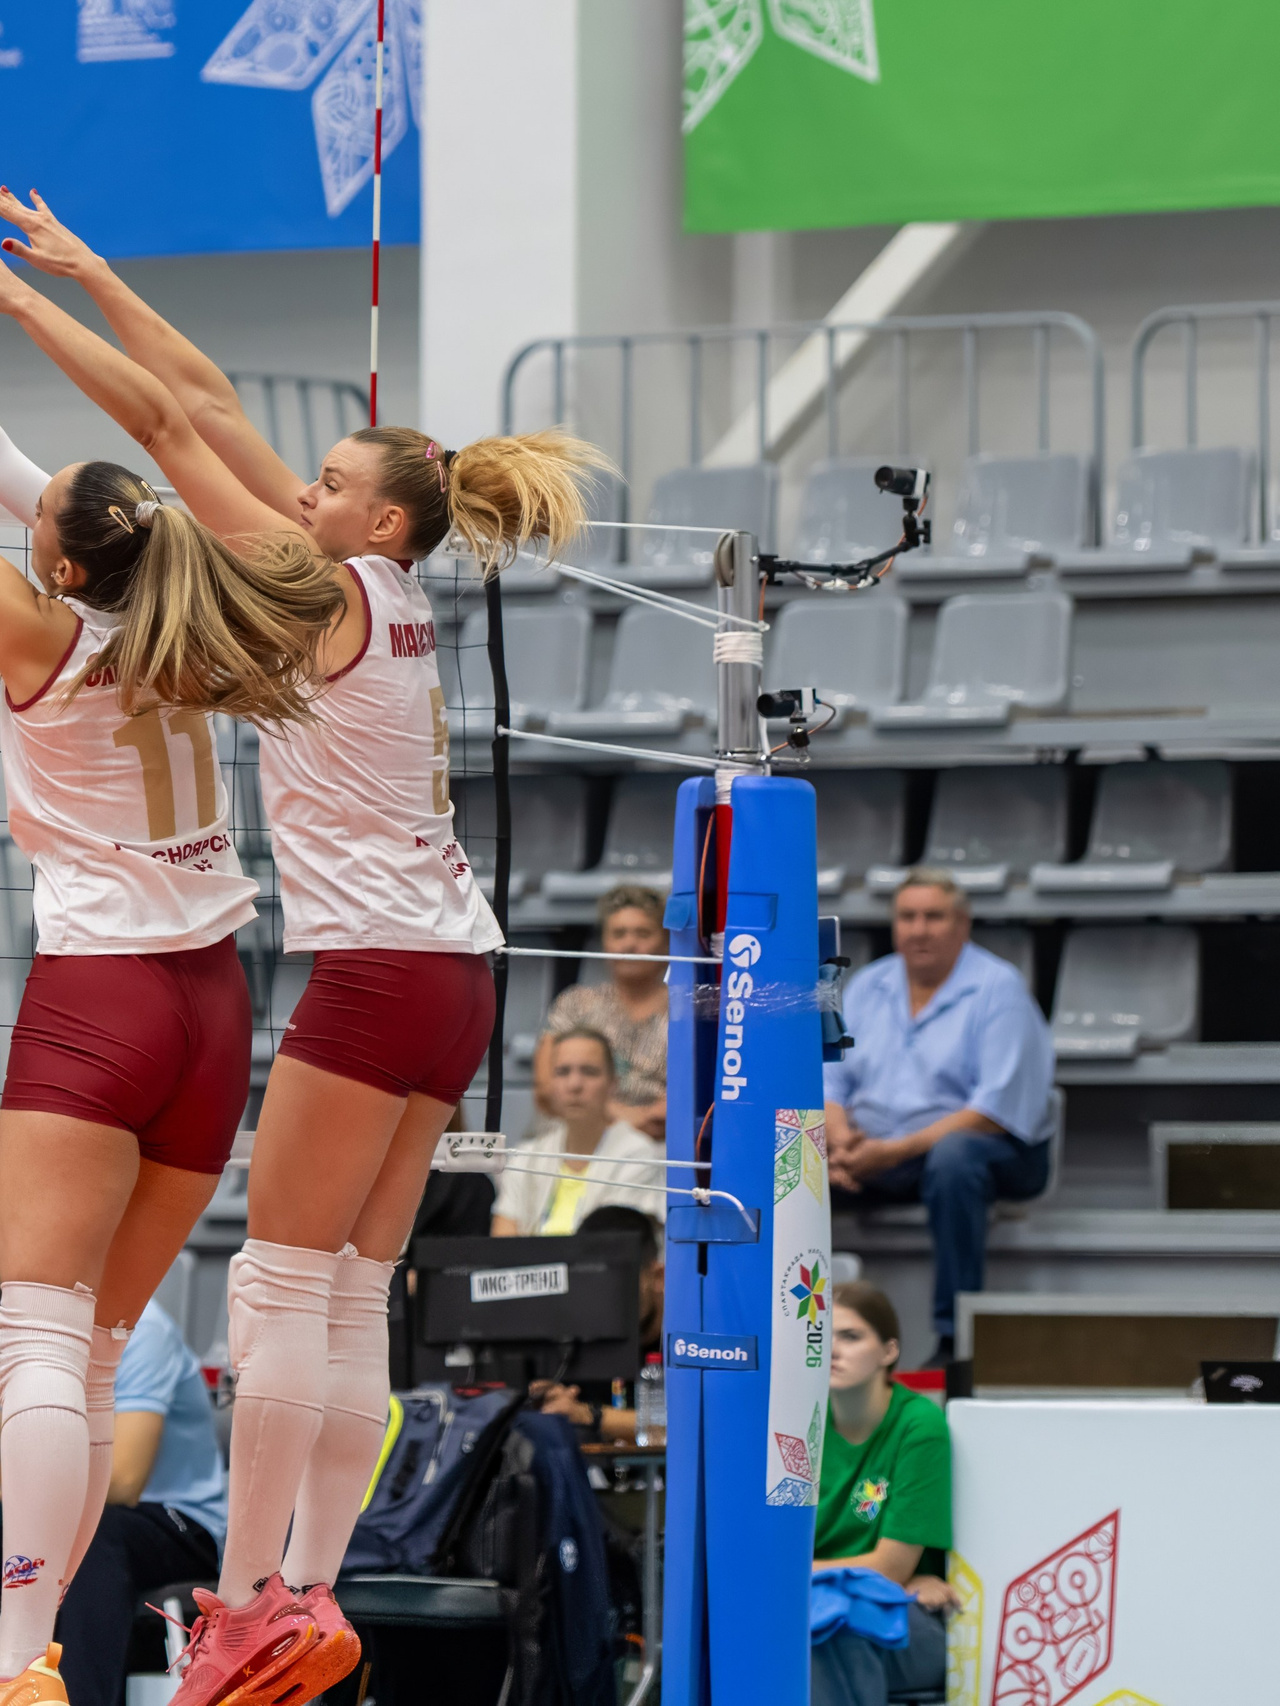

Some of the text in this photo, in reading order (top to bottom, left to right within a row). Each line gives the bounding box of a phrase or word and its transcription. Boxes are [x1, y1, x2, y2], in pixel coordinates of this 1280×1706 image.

[112, 712, 218, 842] 11
[721, 971, 754, 1101] Senoh
[687, 1343, 748, 1361] Senoh
[806, 1320, 824, 1369] 2026
